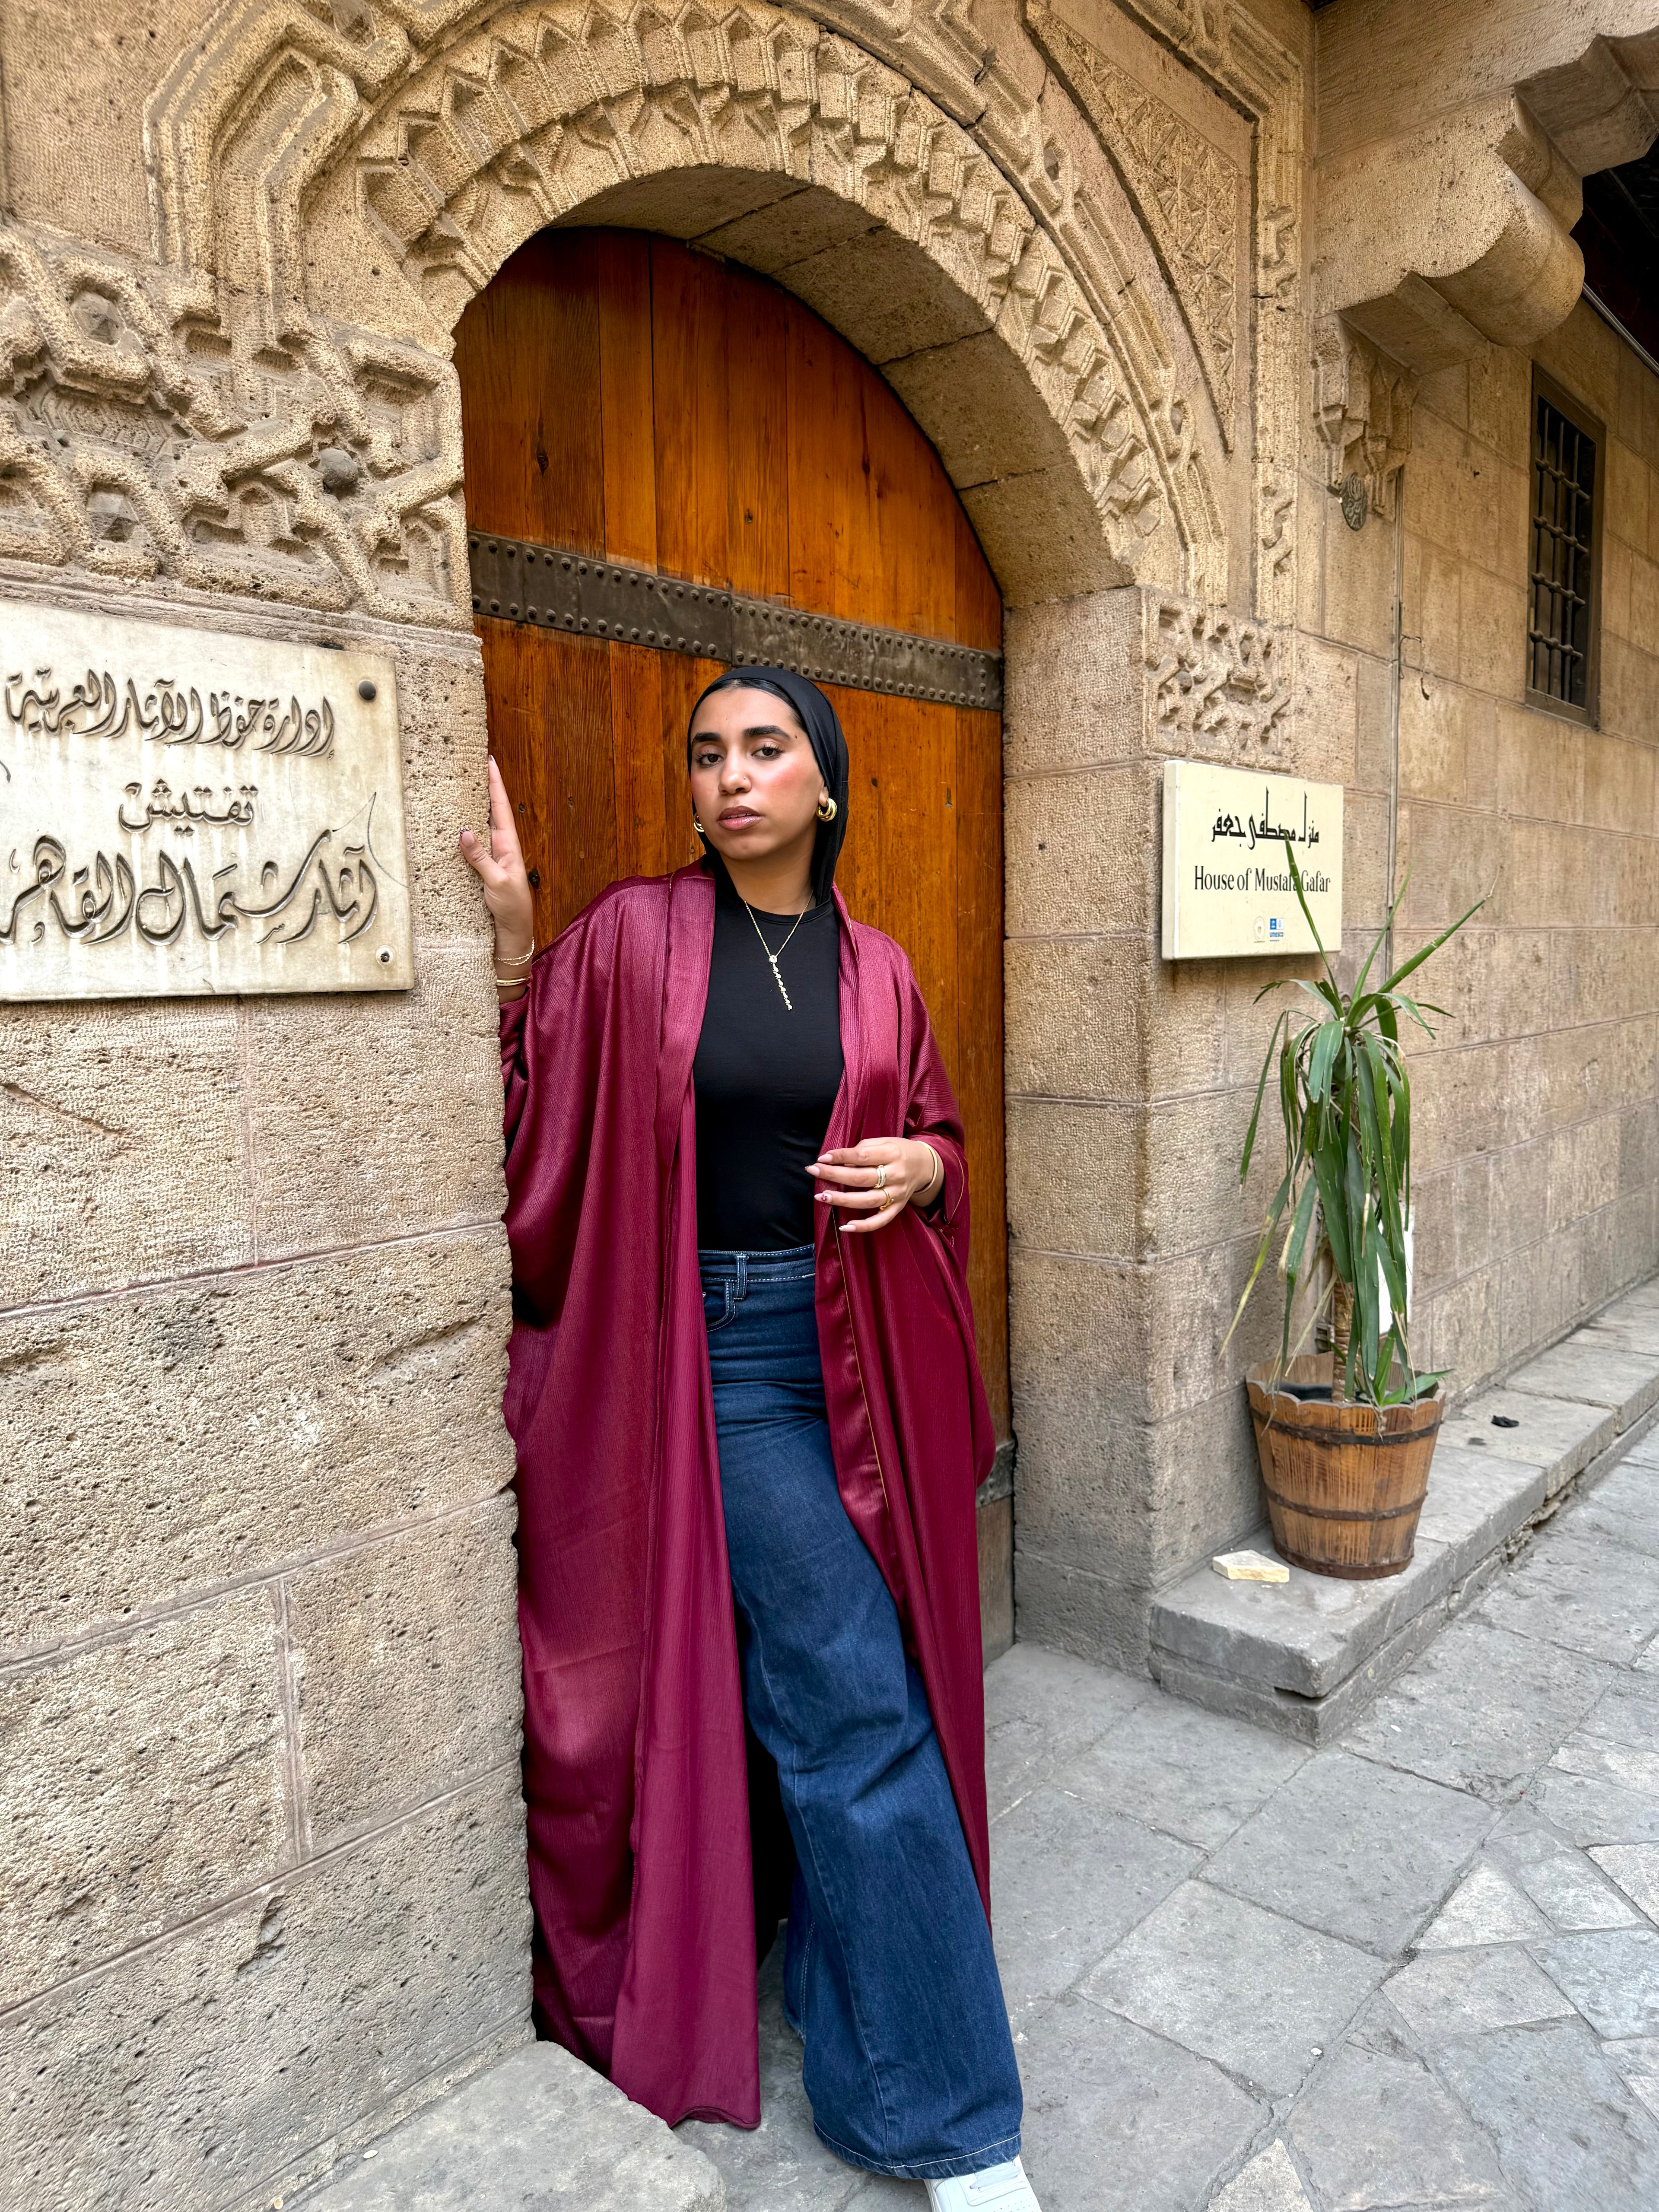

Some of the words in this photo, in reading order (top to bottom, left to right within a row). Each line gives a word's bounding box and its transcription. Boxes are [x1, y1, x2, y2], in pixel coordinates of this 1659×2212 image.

[102, 677, 204, 746] الآثار
[196, 691, 266, 750] حفظ
[253, 695, 335, 760] إدارة
[118, 778, 259, 837] تفتيش
[1211, 808, 1247, 847] جعفر
[1298, 791, 1319, 849] منزل
[0, 835, 135, 947] القاهر
[136, 828, 332, 947] شمال
[276, 845, 378, 945] آثار
[1195, 865, 1234, 890] House
[1237, 868, 1252, 890] of
[1301, 870, 1331, 892] Gafar
